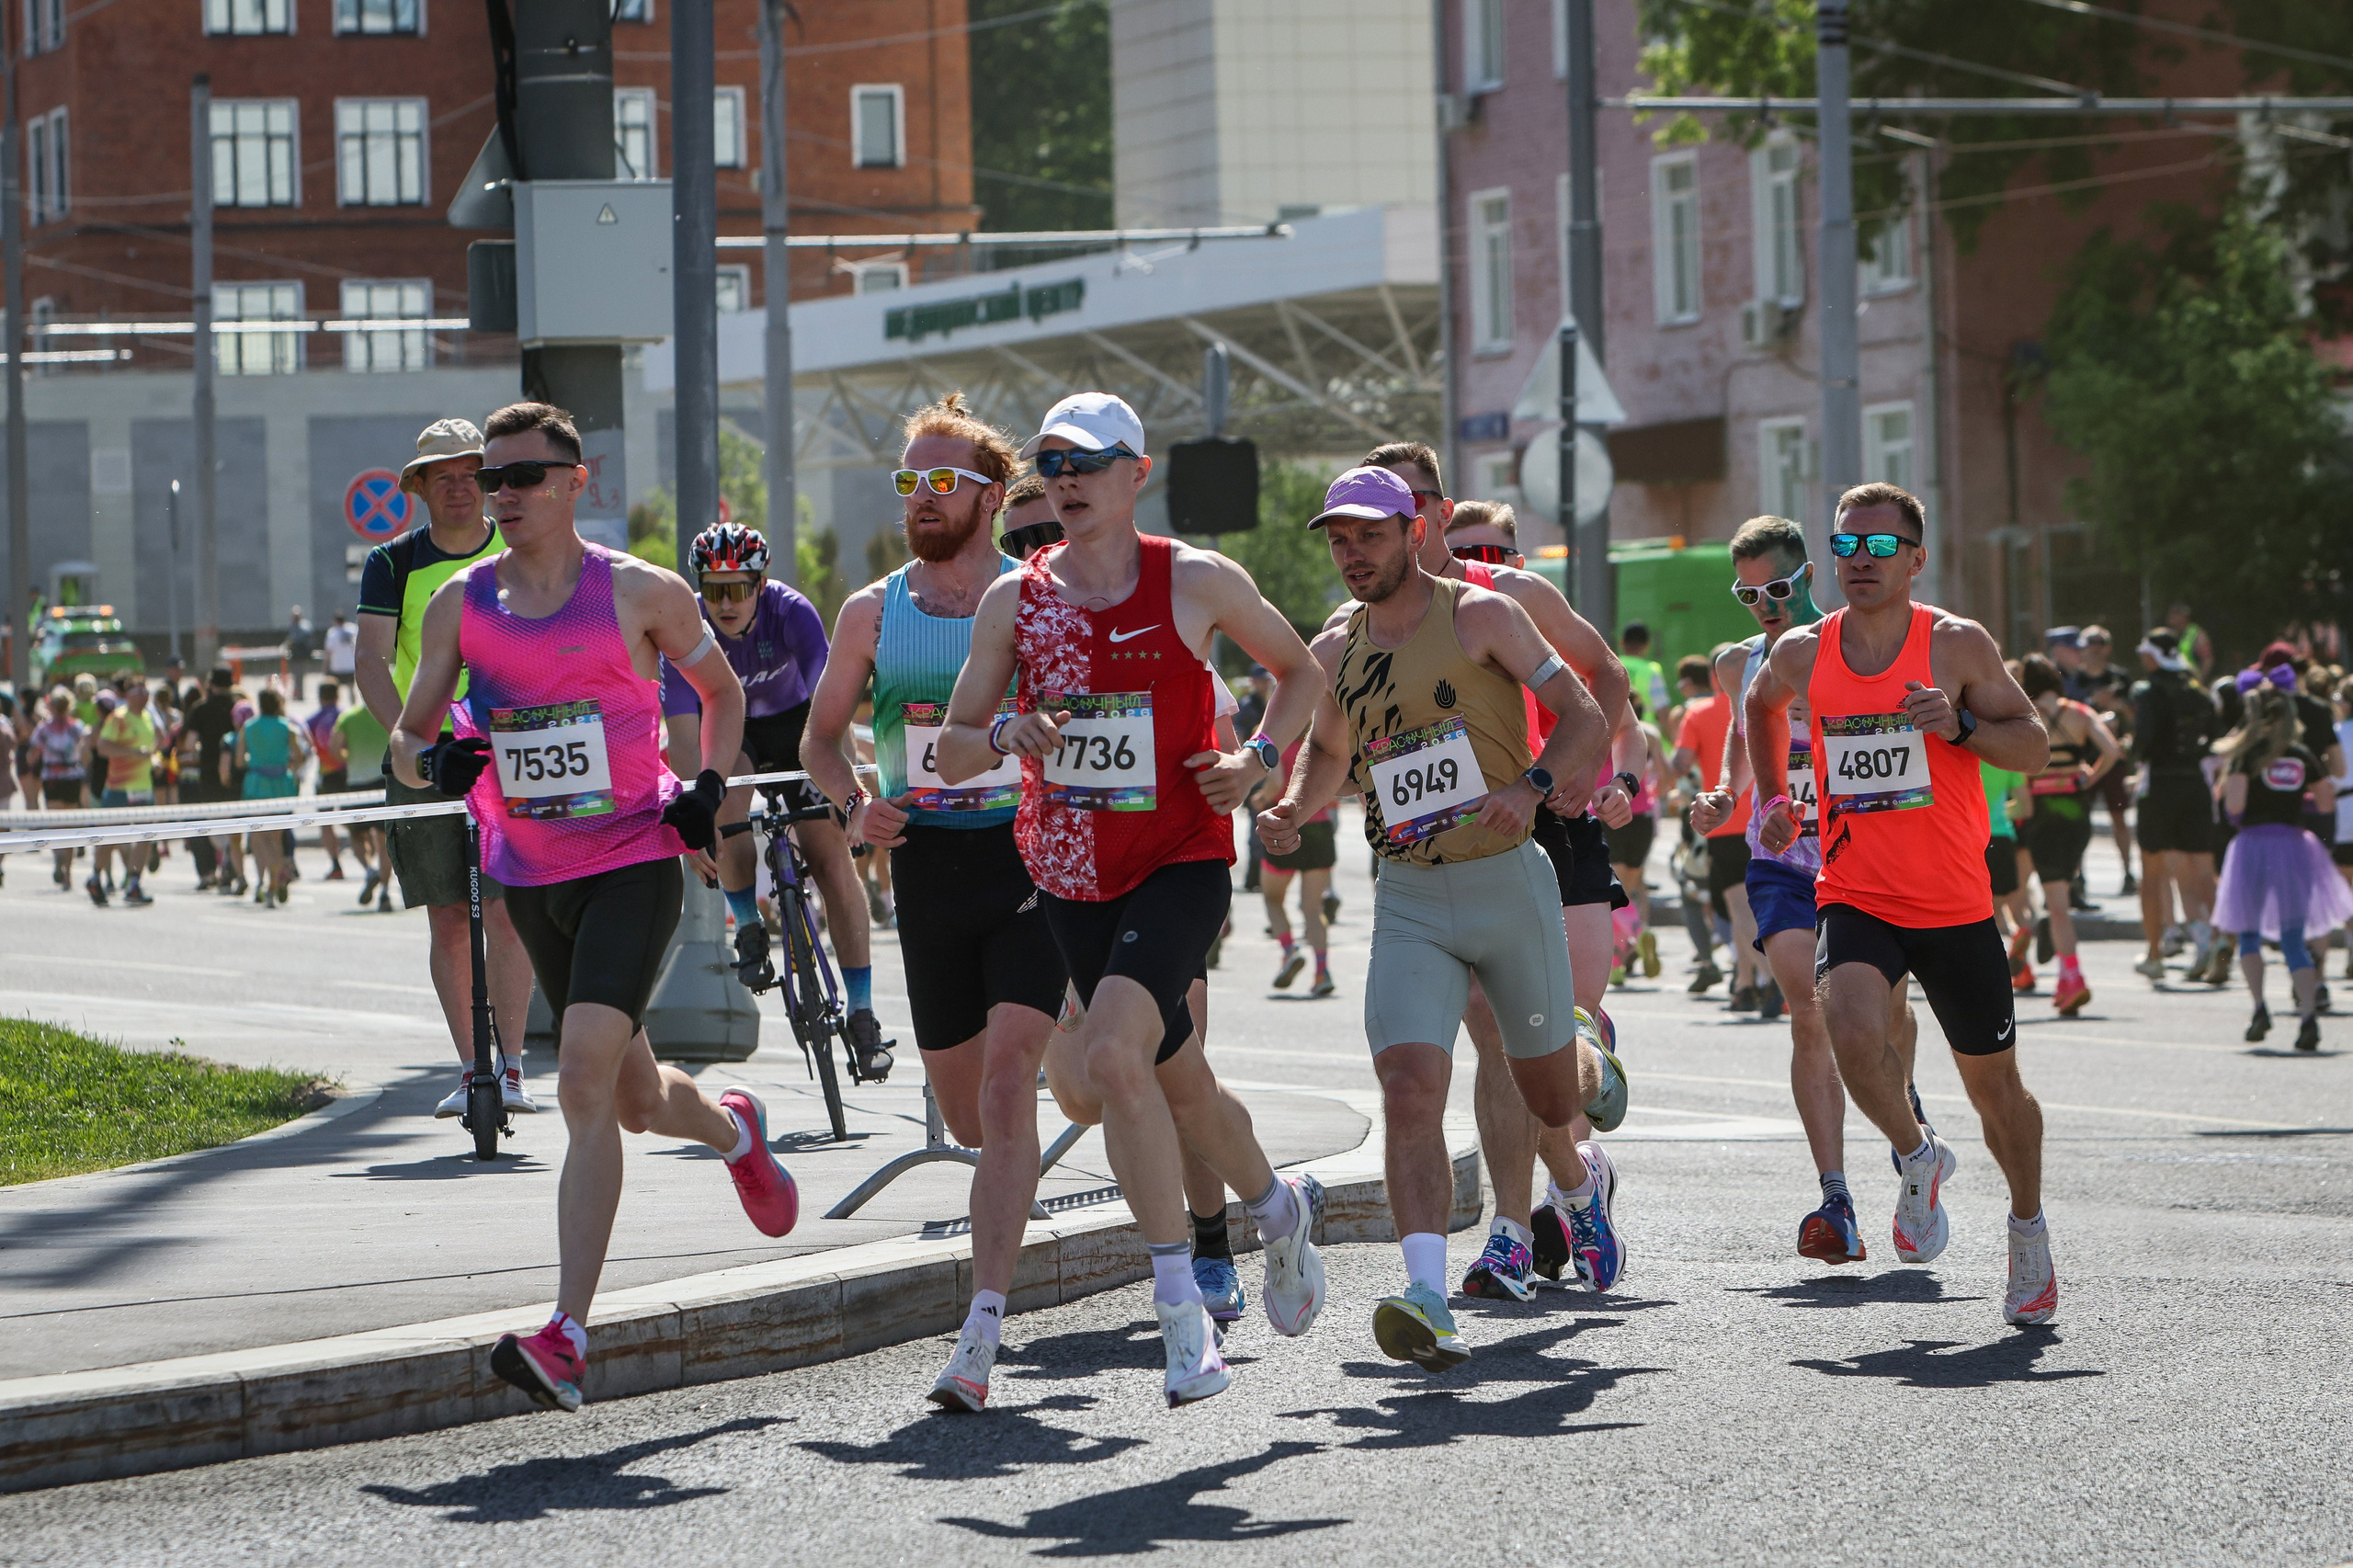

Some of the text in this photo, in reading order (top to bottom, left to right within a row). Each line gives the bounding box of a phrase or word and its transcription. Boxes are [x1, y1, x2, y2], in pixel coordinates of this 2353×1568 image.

[493, 700, 591, 724] КРАСОЧНЫЙ
[1044, 693, 1142, 710] КРАСОЧНЫЙ
[1370, 720, 1455, 756] КРАСОЧНЫЙ
[505, 741, 590, 781] 7535
[1838, 745, 1910, 780] 4807
[1392, 758, 1459, 806] 6949
[469, 866, 480, 918] KUGOO S3
